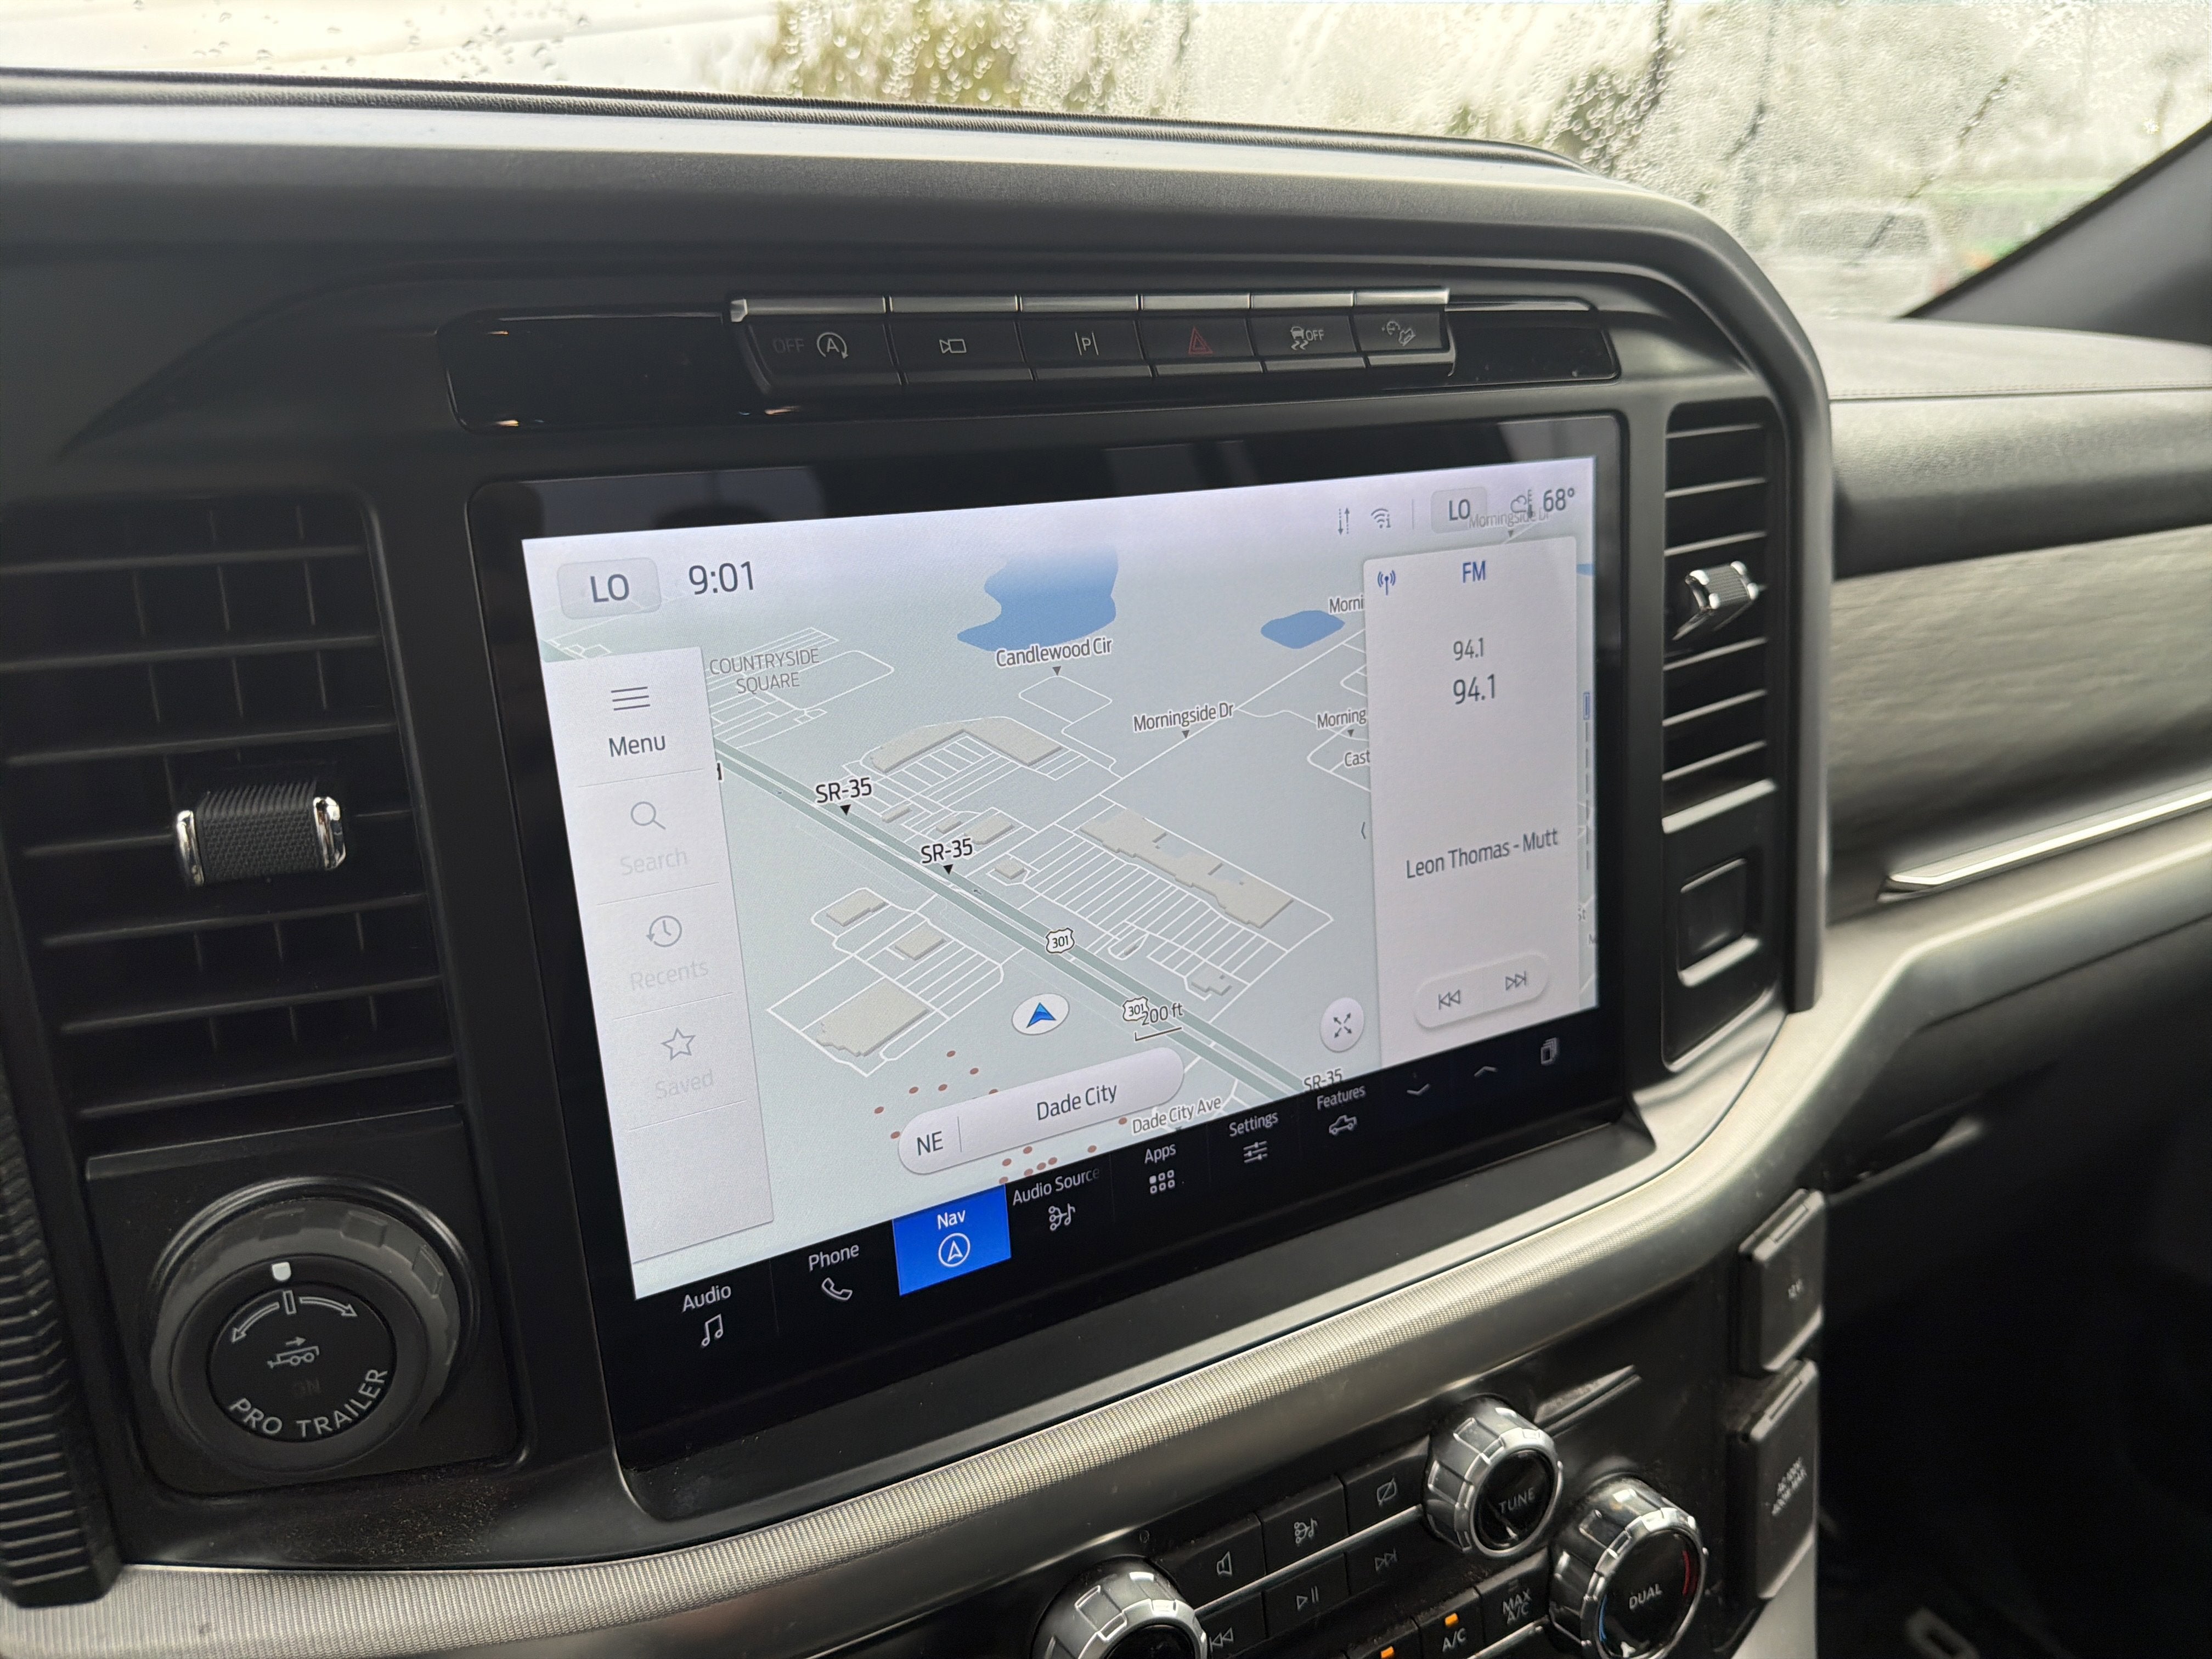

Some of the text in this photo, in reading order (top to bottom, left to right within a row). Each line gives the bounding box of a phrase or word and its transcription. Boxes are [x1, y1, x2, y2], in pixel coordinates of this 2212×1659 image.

[772, 337, 805, 353] OFF
[1081, 336, 1092, 352] P
[1305, 328, 1325, 341] OFF
[1448, 498, 1471, 522] LO
[1468, 509, 1537, 529] Morningside
[687, 561, 755, 596] 9:01
[1462, 560, 1487, 584] FM
[589, 573, 630, 603] LO
[709, 648, 820, 676] COUNTRYSIDE
[995, 636, 1112, 668] Candlewood Cir
[1452, 637, 1485, 661] 94.1
[736, 672, 801, 695] SQUARE
[1452, 673, 1496, 705] 94.1
[1133, 703, 1234, 731] Morningside Dr
[1317, 708, 1367, 729] Morning
[608, 735, 667, 758] Menu
[1344, 749, 1370, 768] Cast
[815, 777, 873, 804] SR-35
[619, 848, 689, 876] Search
[919, 838, 973, 865] SR-35
[1406, 857, 1445, 879] Leon
[1447, 839, 1510, 870] Thomas
[1521, 828, 1559, 854] Mutt
[1051, 934, 1070, 949] 301
[629, 960, 709, 991] Recents
[1128, 1003, 1144, 1017] 301
[1141, 1002, 1183, 1026] 200 ft
[655, 1069, 714, 1099] Saved
[1303, 1068, 1343, 1092] SR-35
[1037, 1082, 1118, 1121] Dade City
[1317, 1085, 1367, 1111] Features
[1132, 1097, 1221, 1134] Dade City Ave
[1228, 1110, 1279, 1138] Settings
[916, 1130, 944, 1156] NE
[1144, 1142, 1177, 1165] Apps
[1012, 1167, 1100, 1207] Audio Source
[936, 1208, 966, 1231] Nav
[808, 1242, 860, 1272] Phone
[682, 1283, 732, 1313] Audio
[229, 1369, 388, 1437] PRO TRAILER
[1498, 1487, 1536, 1514] TUNE
[1502, 1588, 1532, 1615] MAX
[1628, 1583, 1663, 1610] DUAL
[1506, 1601, 1531, 1625] A/C
[1442, 1627, 1468, 1652] A/C
